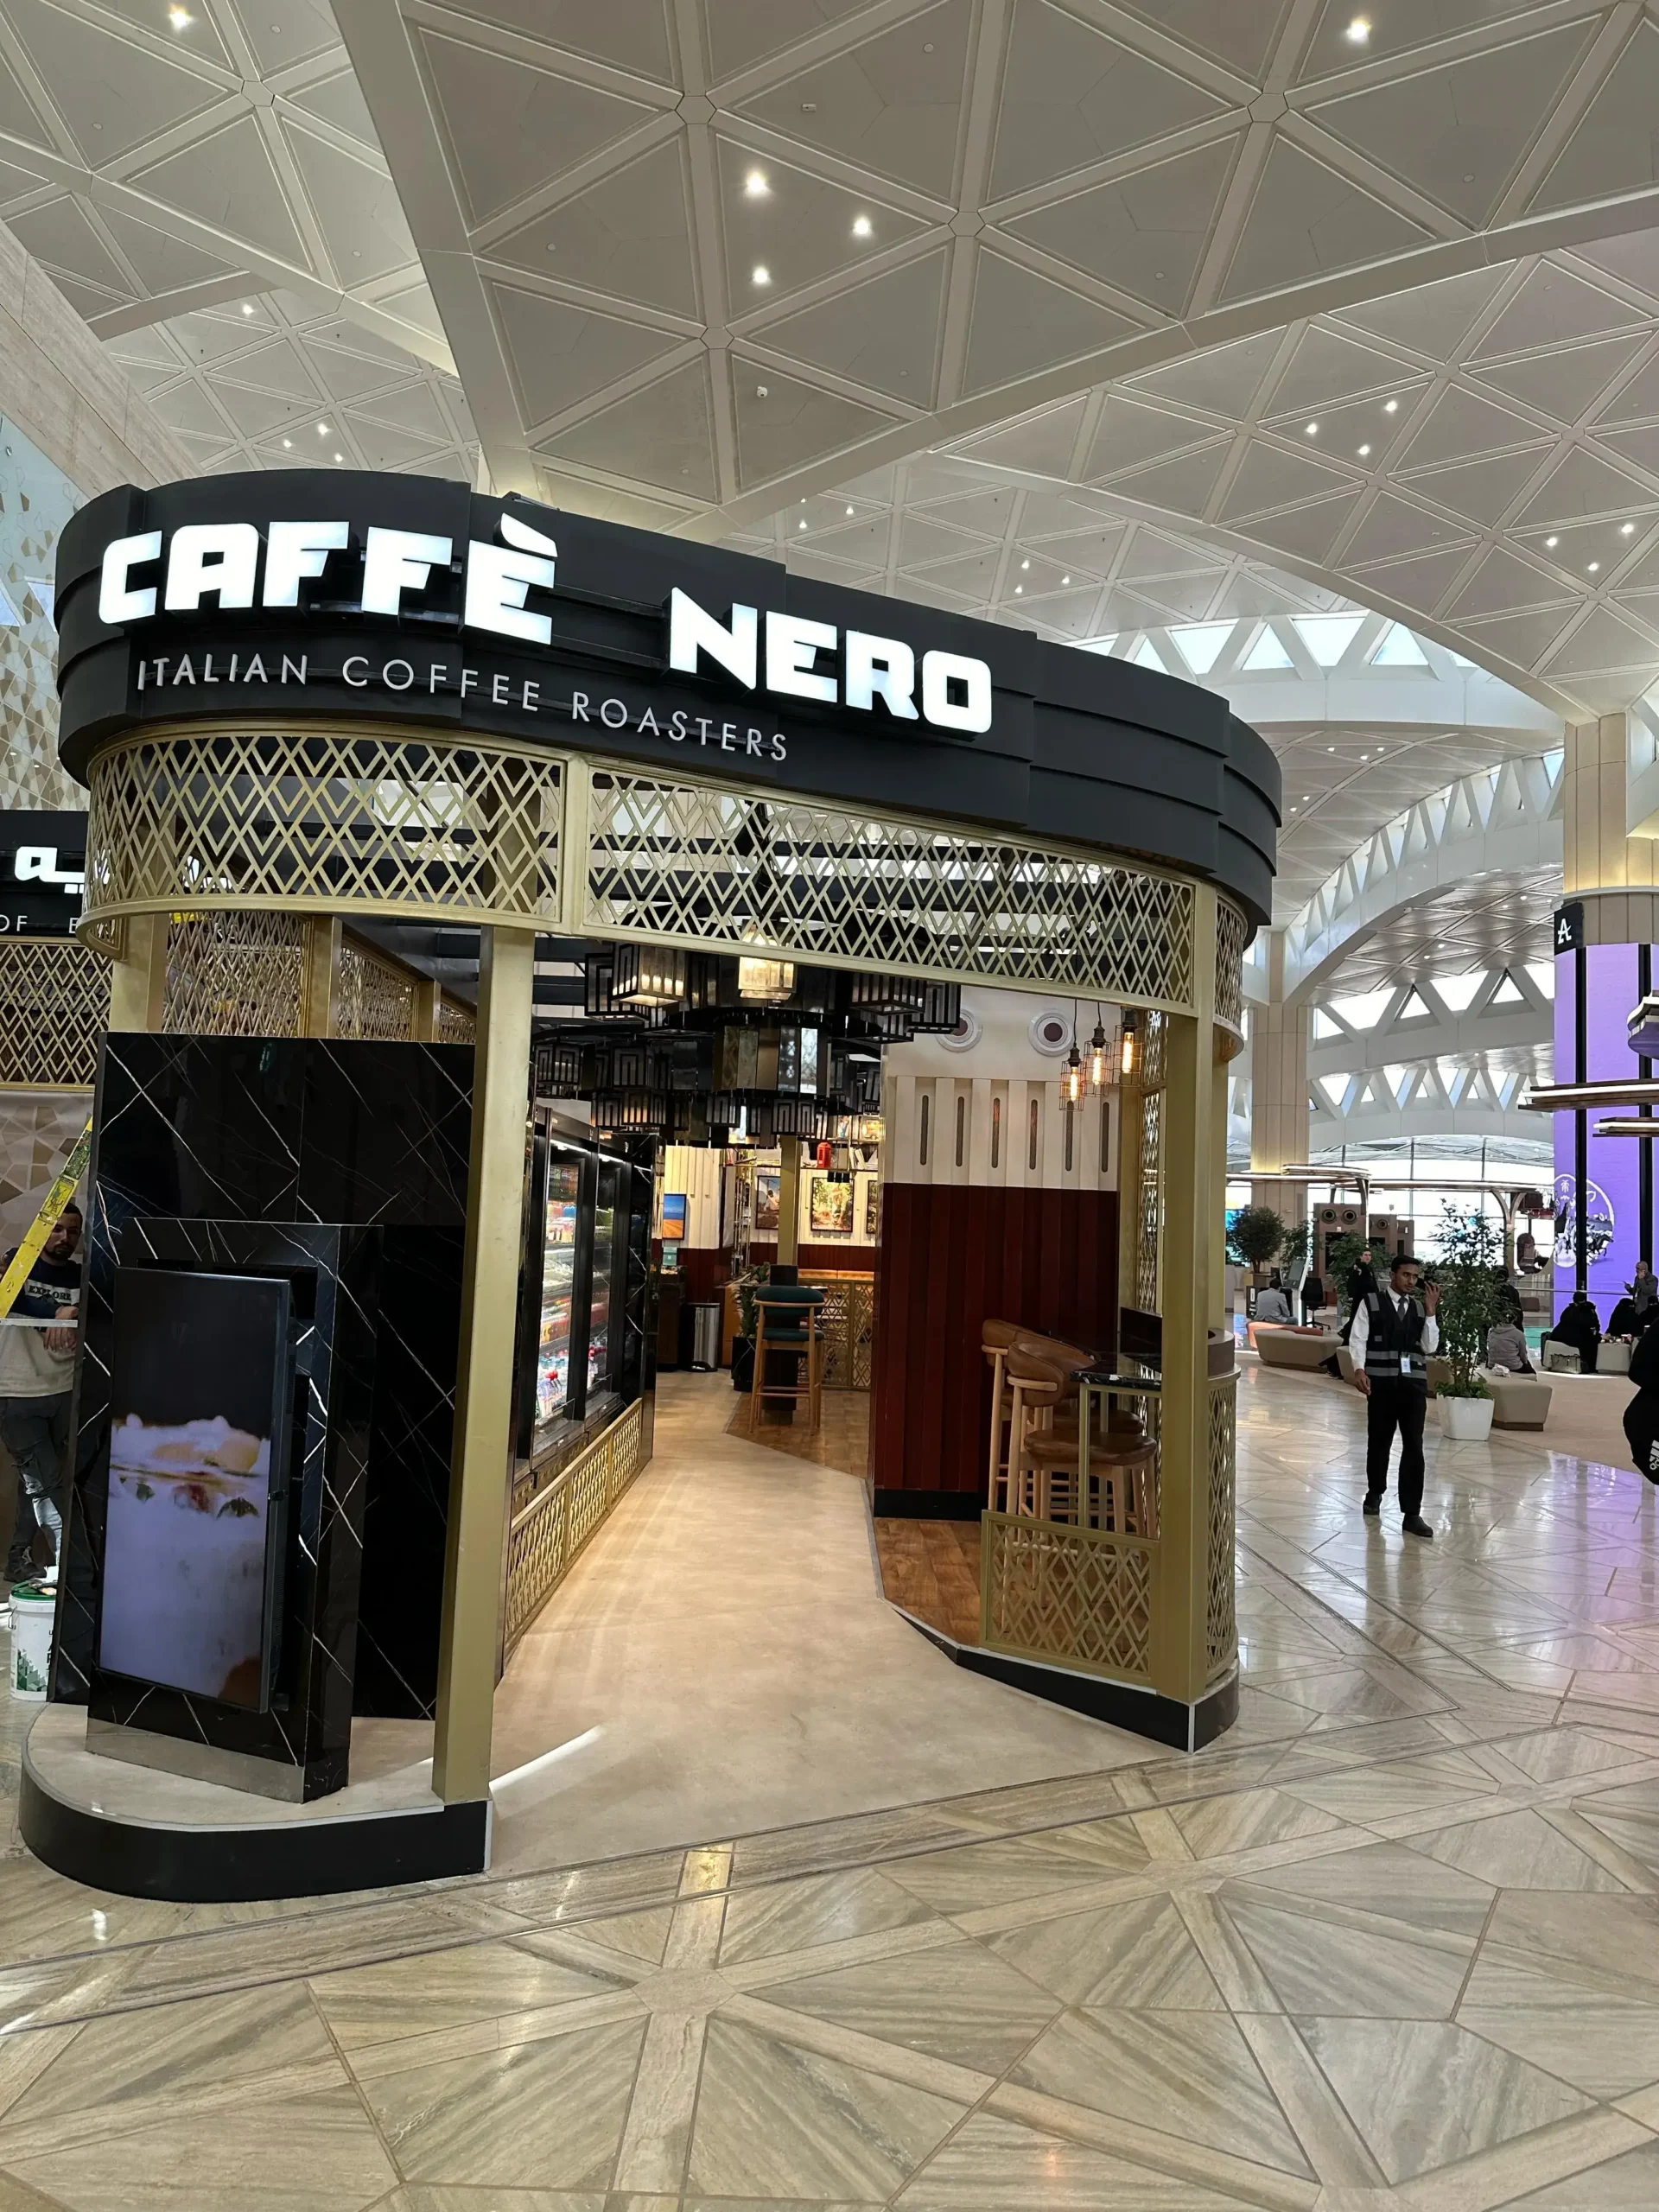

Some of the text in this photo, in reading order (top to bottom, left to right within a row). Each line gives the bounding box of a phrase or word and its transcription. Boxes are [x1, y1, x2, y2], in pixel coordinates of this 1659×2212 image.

[99, 512, 992, 734] CAFFÈ NERO
[137, 653, 788, 762] ITALIAN COFFEE ROASTERS
[1558, 918, 1572, 944] A
[29, 1285, 71, 1300] EXPLORE
